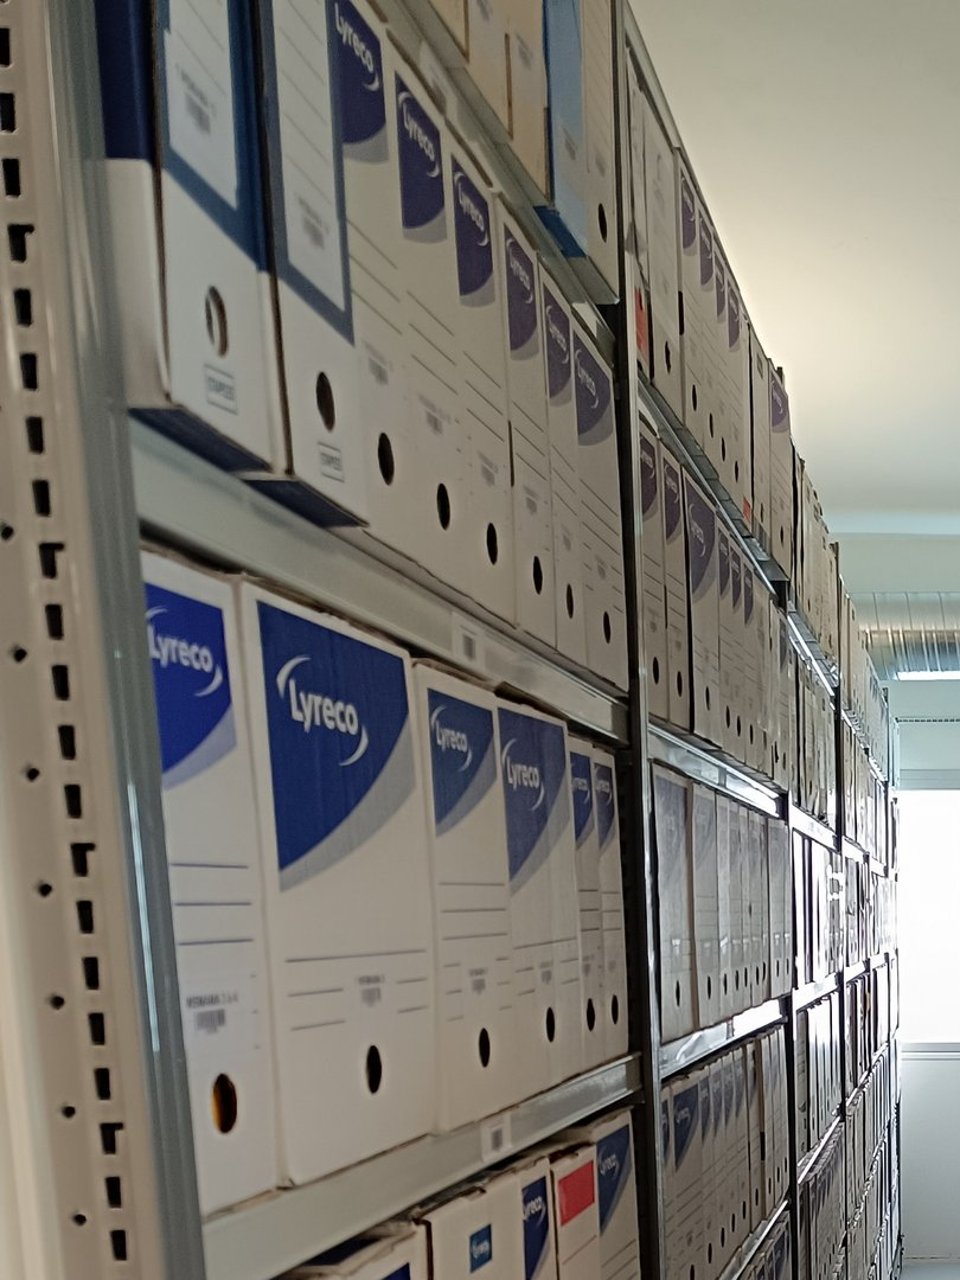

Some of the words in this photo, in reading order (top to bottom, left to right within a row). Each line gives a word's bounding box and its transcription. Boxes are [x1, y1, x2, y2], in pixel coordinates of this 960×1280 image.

[334, 3, 374, 74] Lyreco
[402, 102, 436, 162] Lyreco
[457, 187, 486, 232] Lyreco
[289, 678, 360, 736] Lyreco
[435, 720, 468, 752] Lyreco
[506, 756, 541, 791] Lyreco
